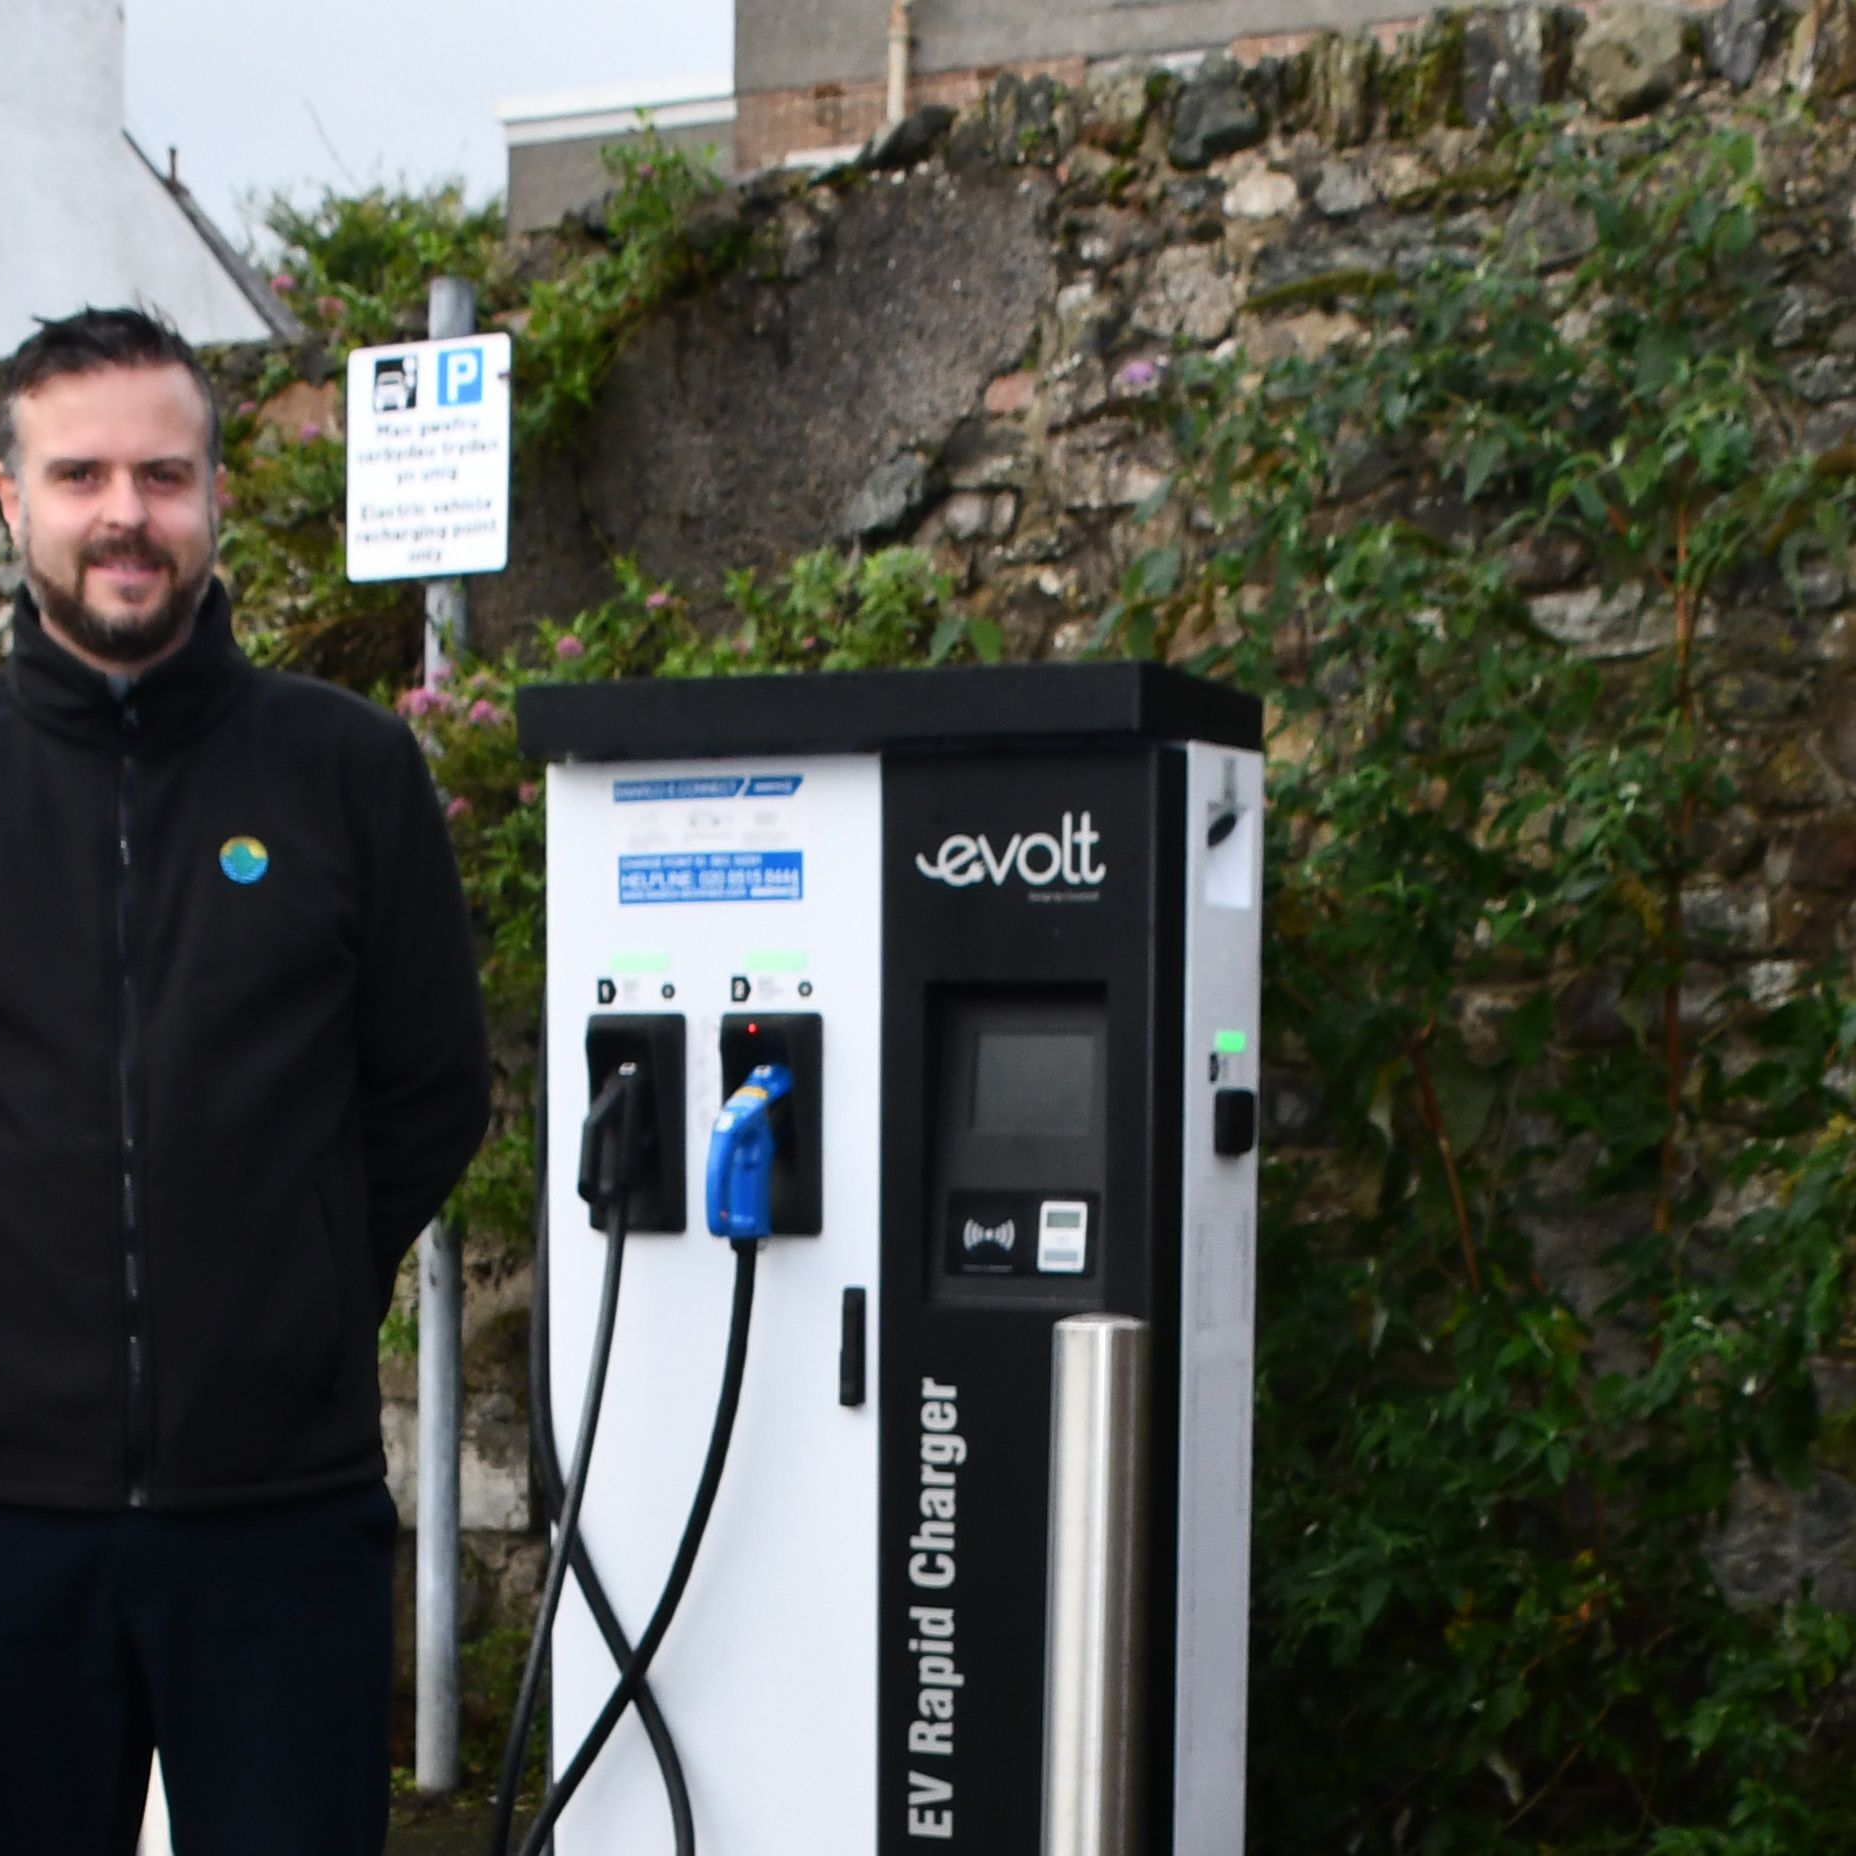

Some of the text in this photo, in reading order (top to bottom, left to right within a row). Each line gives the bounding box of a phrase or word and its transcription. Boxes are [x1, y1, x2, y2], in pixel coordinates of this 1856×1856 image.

[446, 351, 479, 402] P
[422, 465, 459, 481] unig
[360, 496, 492, 521] Electric vehicle
[354, 517, 497, 543] recharging point
[408, 546, 443, 562] only
[915, 810, 1107, 887] evolt
[907, 1376, 967, 1839] EV Rapid Charger
